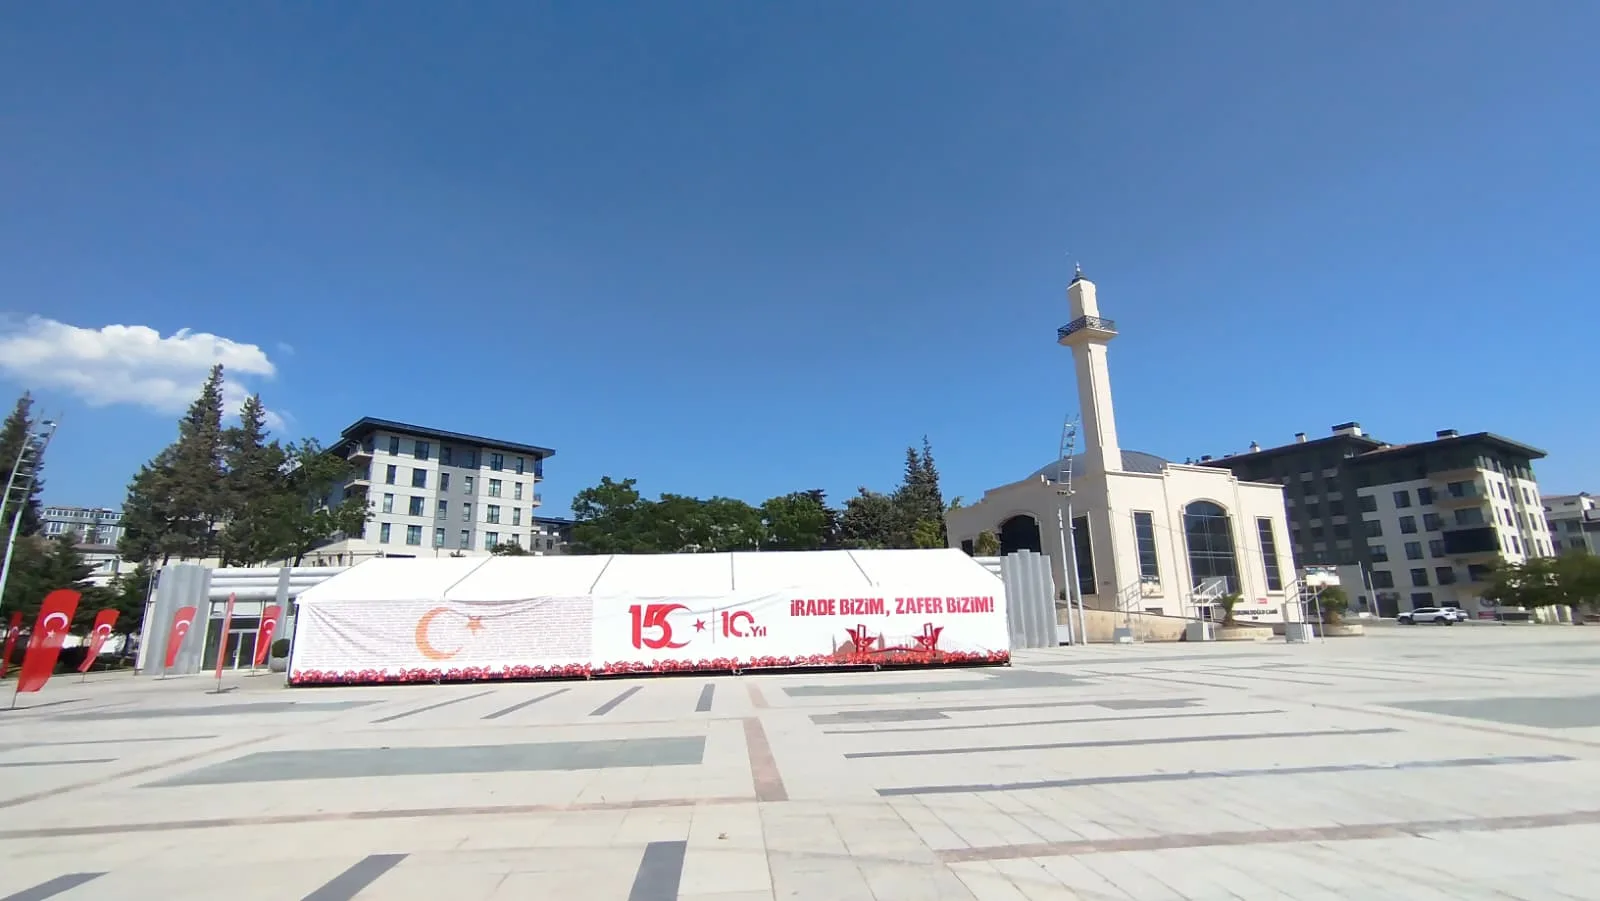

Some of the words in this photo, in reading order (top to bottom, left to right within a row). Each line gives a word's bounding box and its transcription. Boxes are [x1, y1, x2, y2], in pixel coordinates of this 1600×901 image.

[790, 599, 836, 617] İRADE
[839, 597, 890, 617] BİZİM,
[895, 597, 943, 615] ZAFER
[946, 596, 994, 614] BİZİM!
